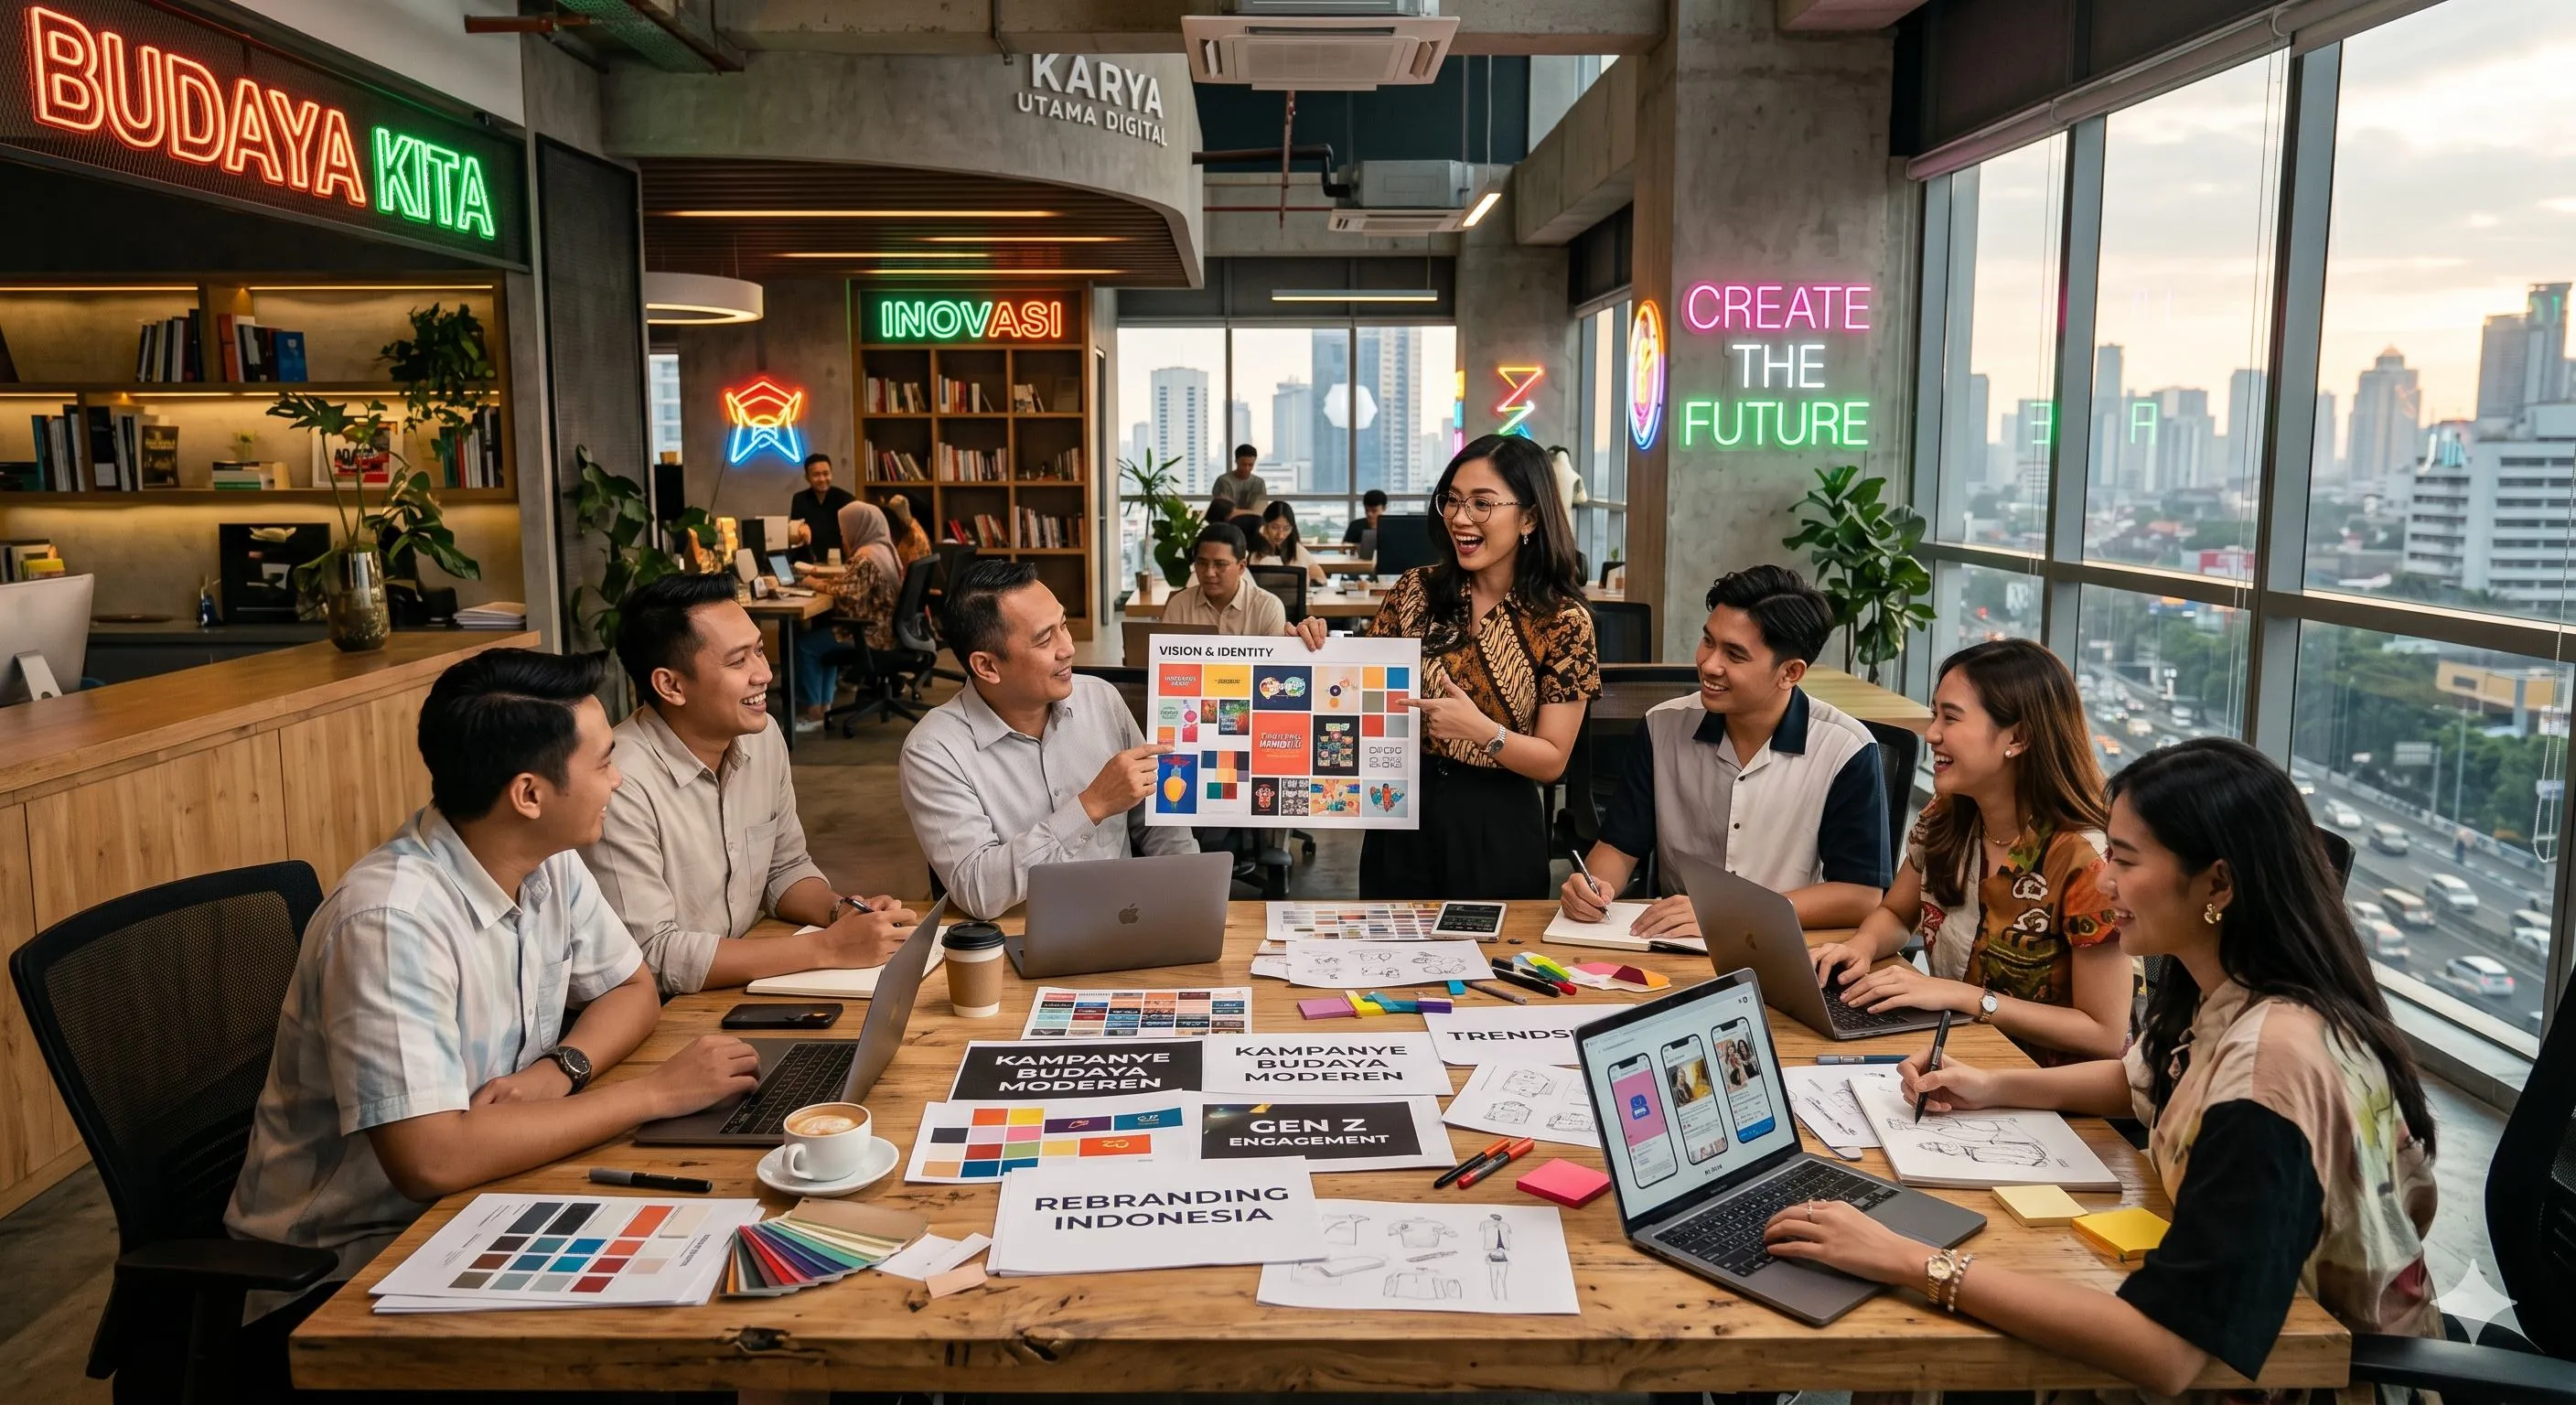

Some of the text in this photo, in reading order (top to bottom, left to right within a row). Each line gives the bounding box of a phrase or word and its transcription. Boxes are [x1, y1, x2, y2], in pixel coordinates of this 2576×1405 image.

[1031, 53, 1164, 119] KARYA
[26, 5, 495, 241] BUDAYA KITA
[1017, 91, 1168, 146] UTAMA DIGITAL
[1687, 284, 1872, 329] CREATE
[881, 300, 1062, 338] INOVASI
[1732, 344, 1826, 389] THE
[1684, 401, 1871, 446] FUTURE
[1158, 645, 1274, 658] VISION & IDENTITY
[1446, 1029, 1574, 1042] TRENDS
[1234, 1046, 1408, 1056] KAMPANYE
[994, 1053, 1171, 1066] KAMPANYE
[1257, 1058, 1390, 1069] BUDAYA
[1016, 1067, 1148, 1078] BUDAYA
[1245, 1071, 1404, 1082] MODEREN
[998, 1078, 1162, 1092] MODEREN
[1250, 1118, 1367, 1133] GEN Z
[1229, 1134, 1390, 1147] ENGAGEMENT
[1035, 1186, 1289, 1211] REBRANDING
[1054, 1207, 1273, 1230] INDONESIA
